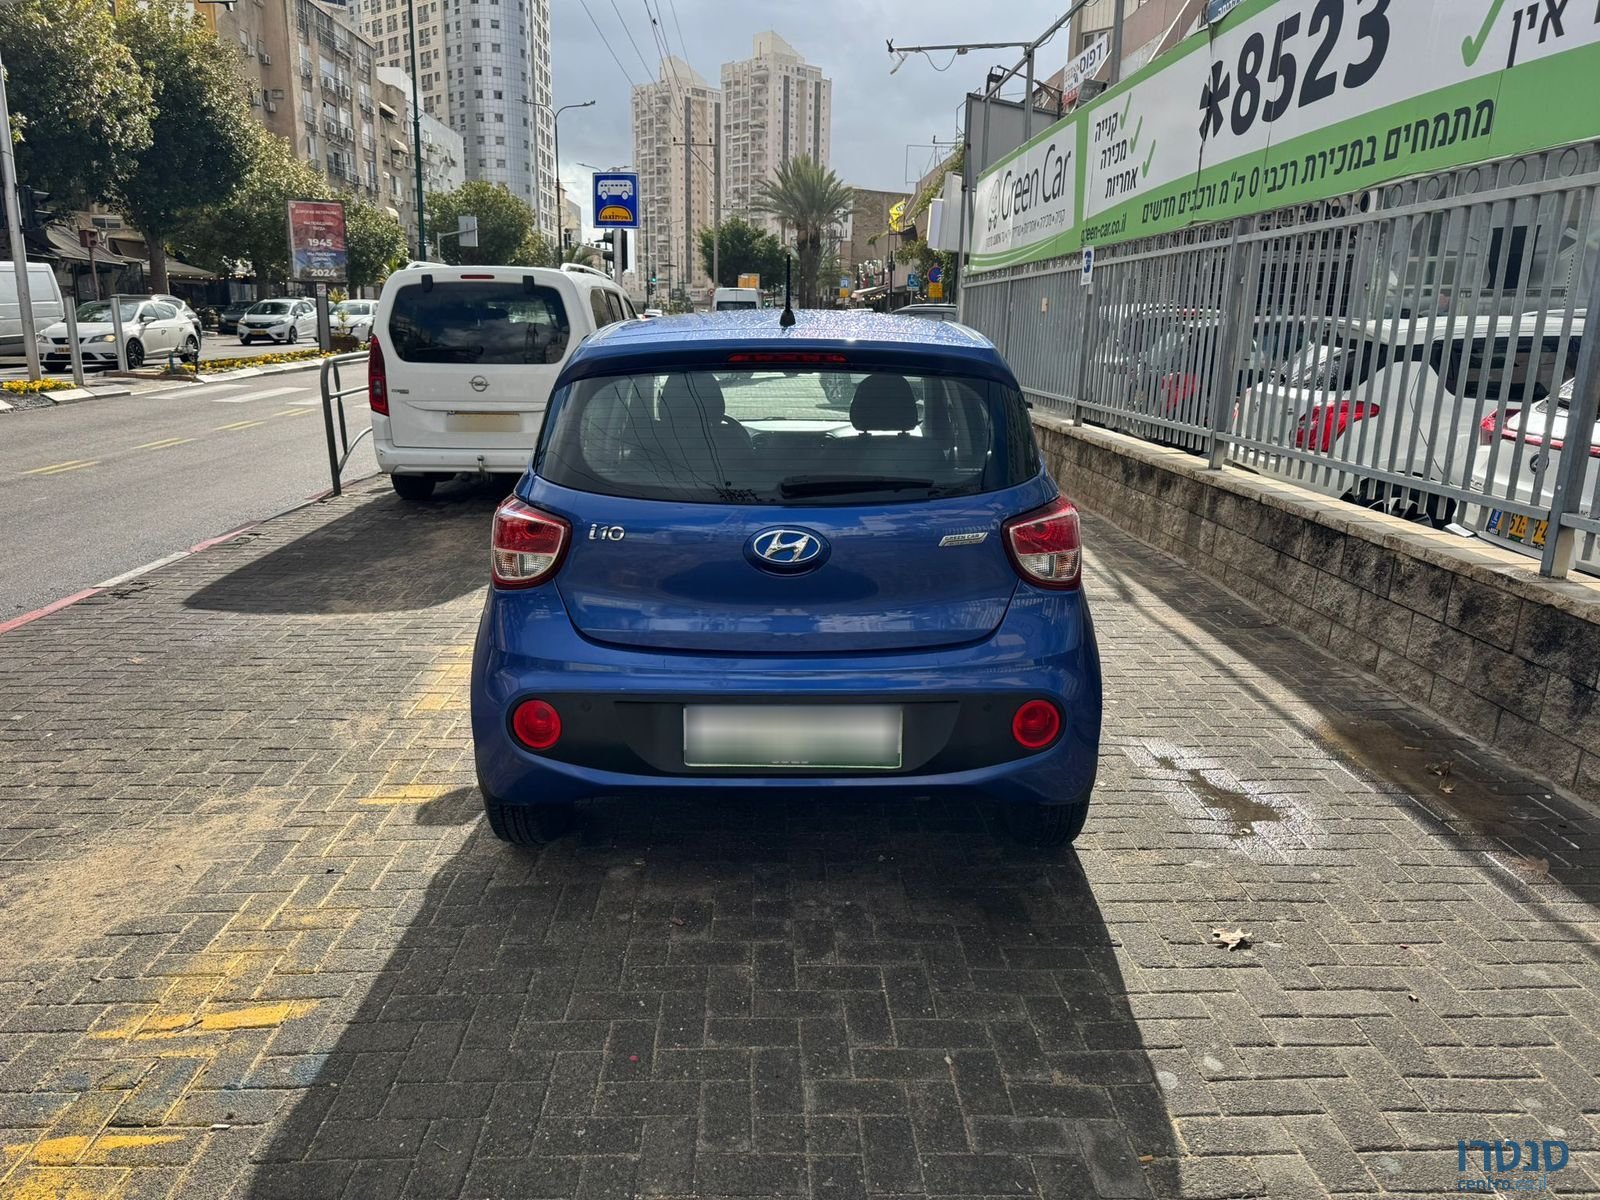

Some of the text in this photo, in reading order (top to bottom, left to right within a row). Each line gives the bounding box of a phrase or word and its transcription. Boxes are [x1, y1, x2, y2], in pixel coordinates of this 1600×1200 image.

[1080, 43, 1102, 74] דפוס
[1095, 112, 1118, 143] קנייה
[1383, 99, 1494, 162] מתמחים
[1100, 139, 1127, 170] מכירה
[1301, 136, 1376, 184] במכירת
[1001, 144, 1071, 220] Green Car
[1105, 167, 1138, 199] אחריות
[1249, 167, 1259, 198] 0
[1264, 160, 1298, 193] רכבי
[1142, 196, 1175, 224] חדשים
[1178, 184, 1216, 214] ורכבים
[307, 238, 333, 247] 1945
[311, 268, 337, 277] 2024
[589, 523, 625, 541] i10
